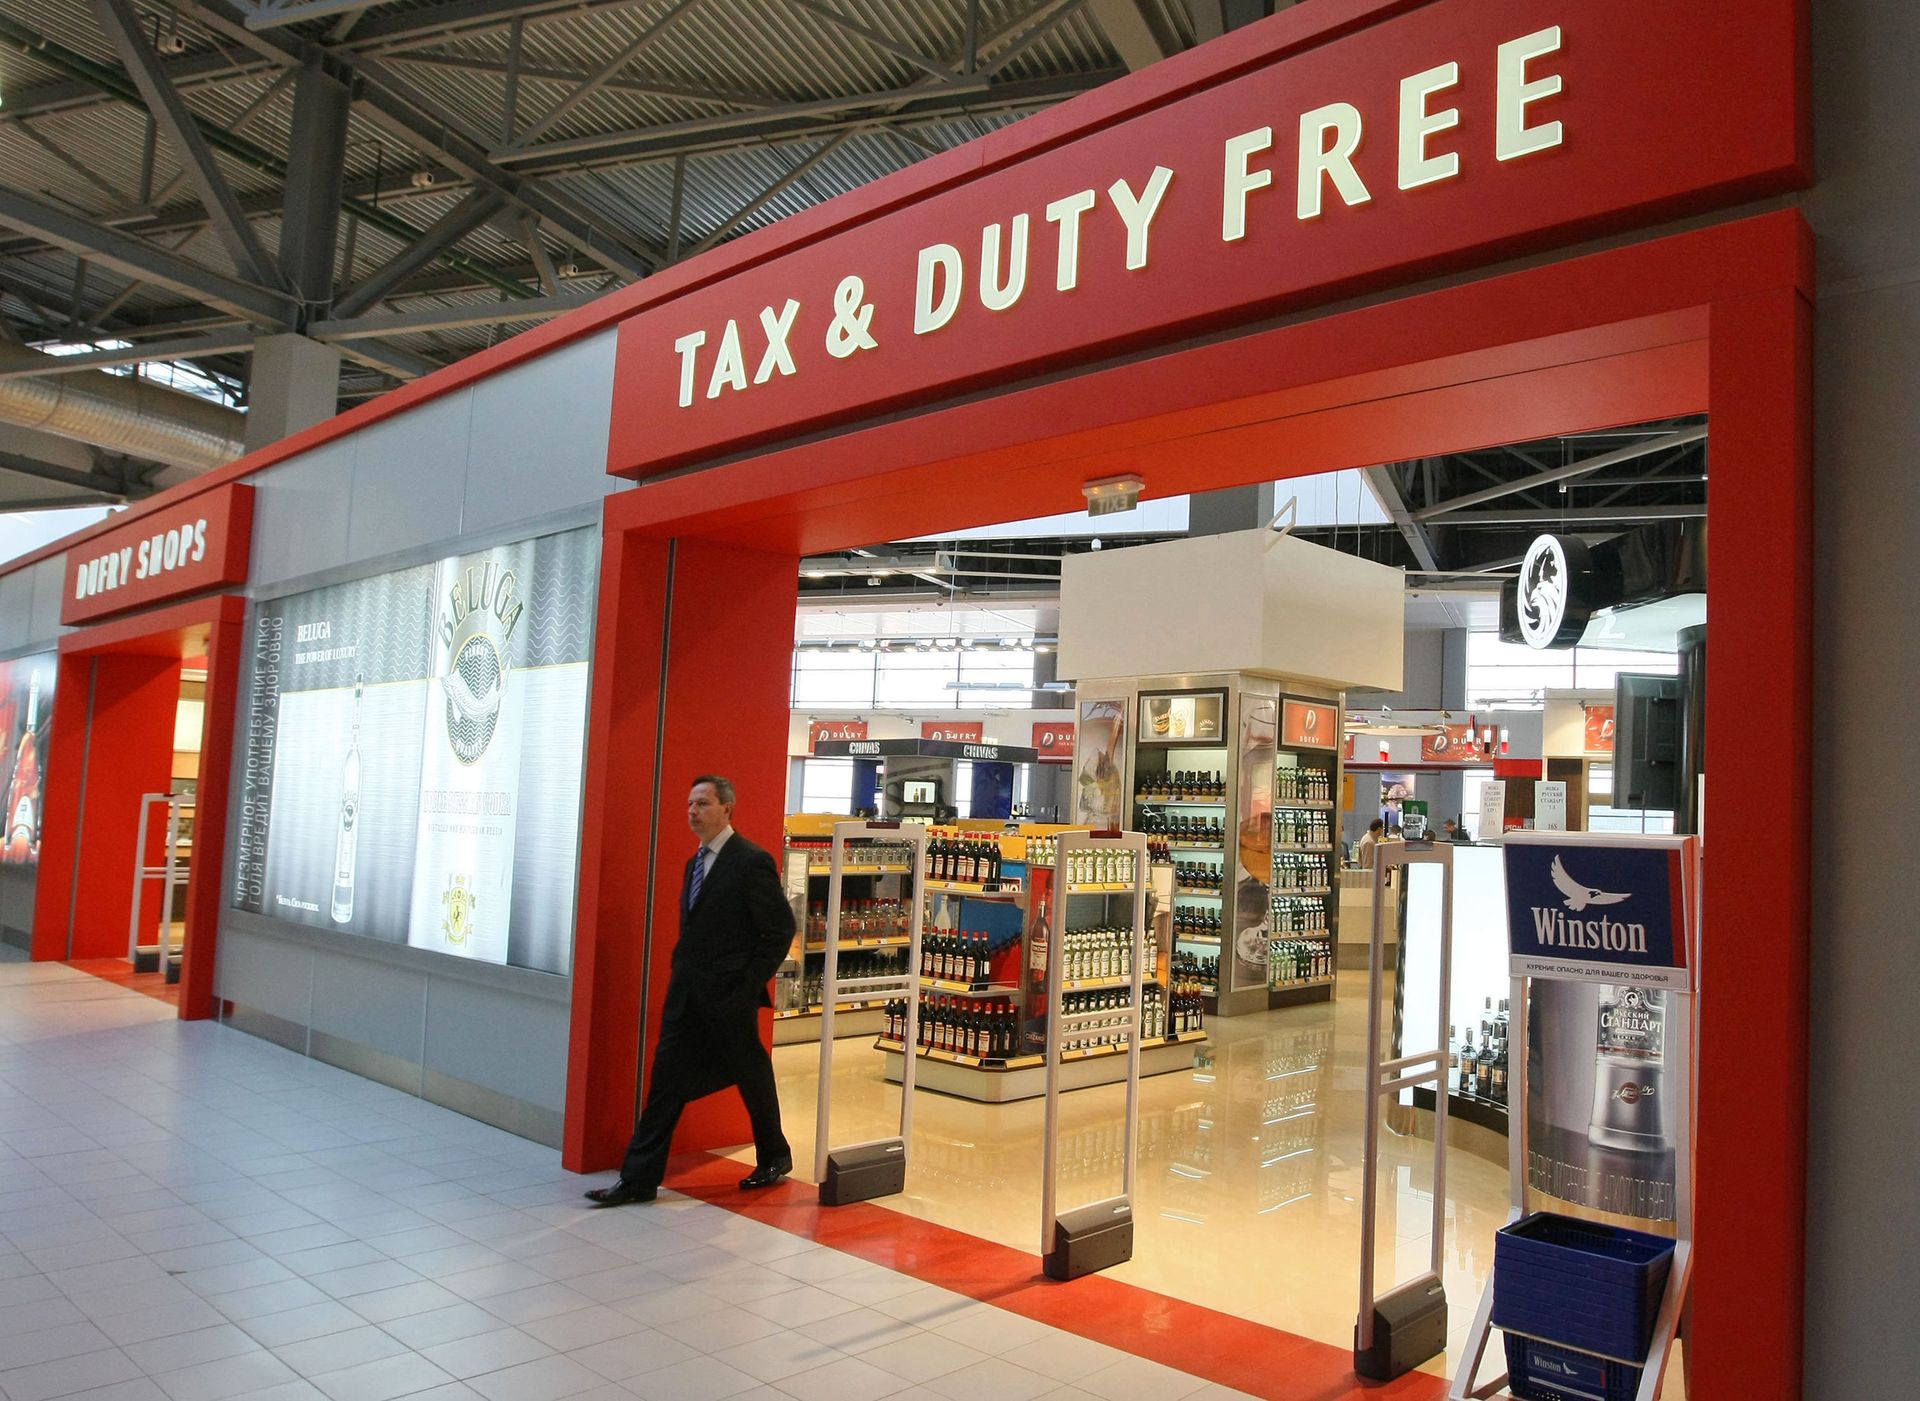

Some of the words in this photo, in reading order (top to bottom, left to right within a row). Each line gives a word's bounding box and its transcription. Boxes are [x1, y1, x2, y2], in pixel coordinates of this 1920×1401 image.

[673, 298, 801, 408] TAX
[825, 275, 879, 359] &
[913, 165, 1174, 335] DUTY
[1222, 25, 1563, 242] FREE
[75, 546, 134, 600] DUFRY
[136, 518, 207, 580] SHOPS
[438, 560, 524, 651] BELUGA
[296, 621, 332, 643] BELUGA
[264, 617, 284, 709] ЗДОРОВЬЮ
[245, 666, 267, 791] УПОТРЕБЛЕНИЕ
[258, 713, 276, 786] ВАШЕМУ
[849, 741, 880, 755] CHIVAS
[945, 732, 977, 741] DUFRY
[963, 744, 999, 760] CHIVAS
[252, 792, 269, 857] ВРЕДИТ
[236, 795, 257, 902] ЧРЕЗМЕРНОЕ
[248, 863, 264, 906] ГОЛЯ
[1530, 906, 1648, 953] Winston
[1526, 963, 1555, 972] КУРЕНИЕ
[1556, 966, 1584, 975] ОПАСНО
[1585, 968, 1600, 976] ДЛЯ
[1601, 970, 1630, 979] ВАШЕГО
[1631, 972, 1669, 982] ЗДОРОВЬЯ
[1601, 1012, 1662, 1032] СТАНДАРТ
[1613, 1008, 1650, 1020] РУССКИЙ
[1533, 1355, 1562, 1373] Winston
